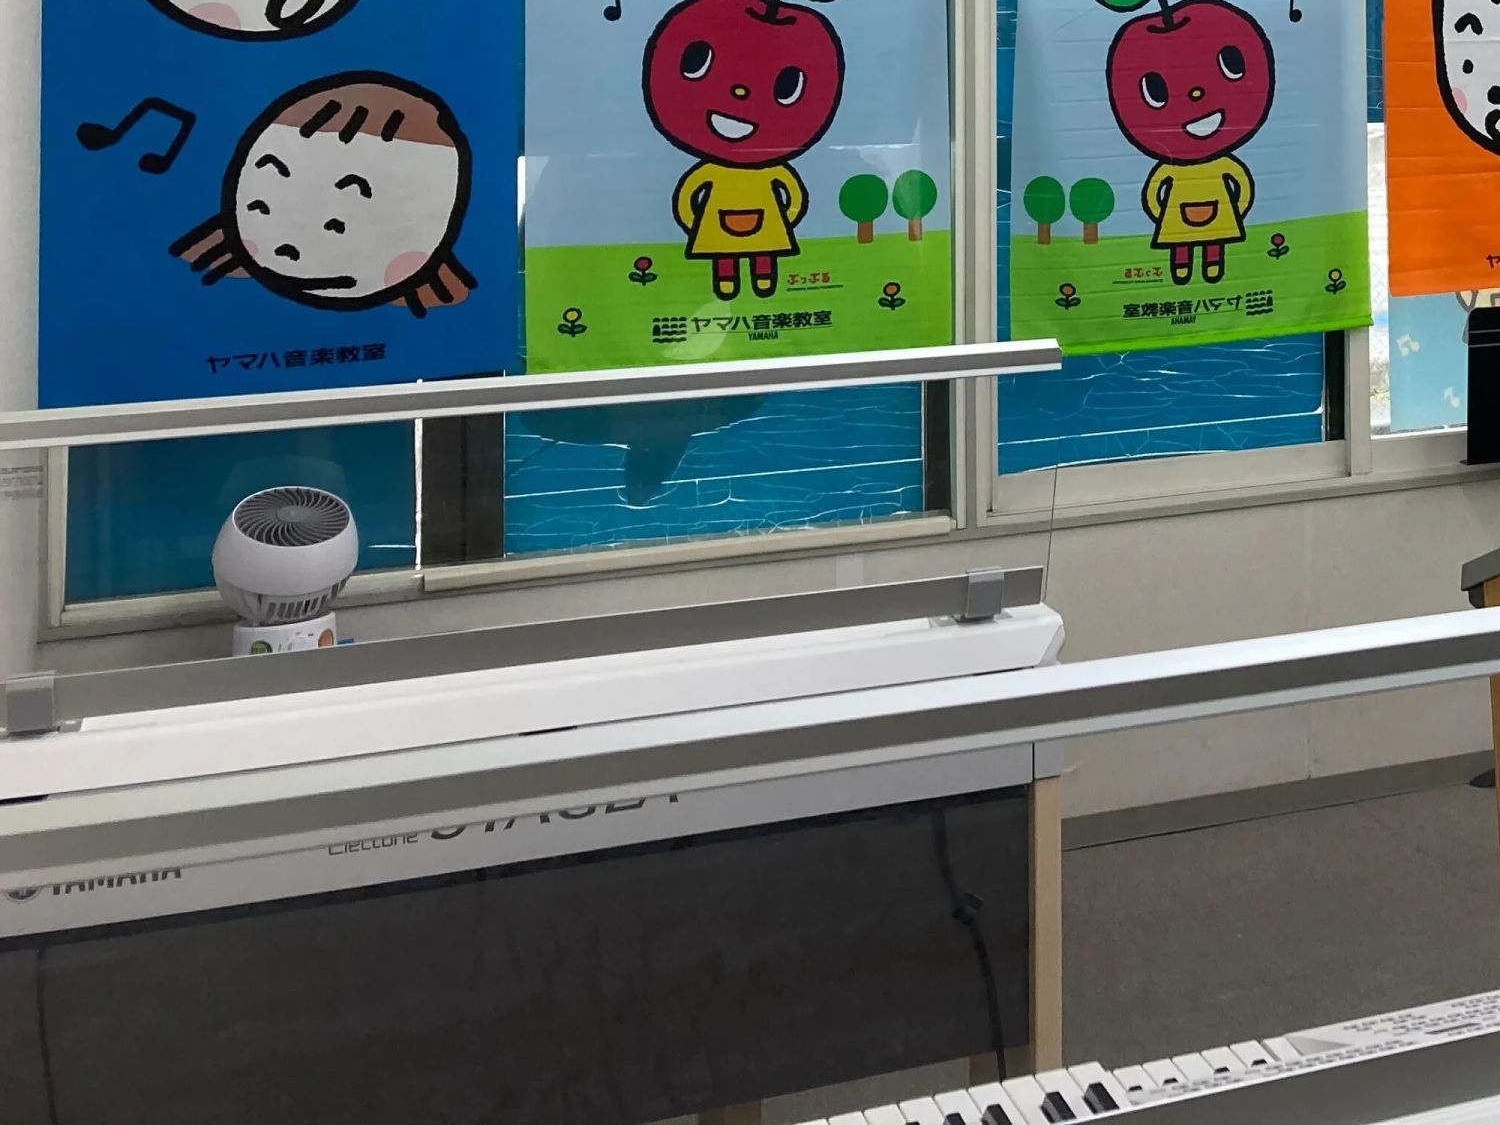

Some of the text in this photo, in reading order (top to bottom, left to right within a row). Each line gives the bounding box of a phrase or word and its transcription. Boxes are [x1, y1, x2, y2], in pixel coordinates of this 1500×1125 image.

[690, 310, 833, 332] ヤマハ音楽教室
[748, 331, 779, 341] YAMAHA
[205, 342, 387, 374] ヤマハ音楽教室
